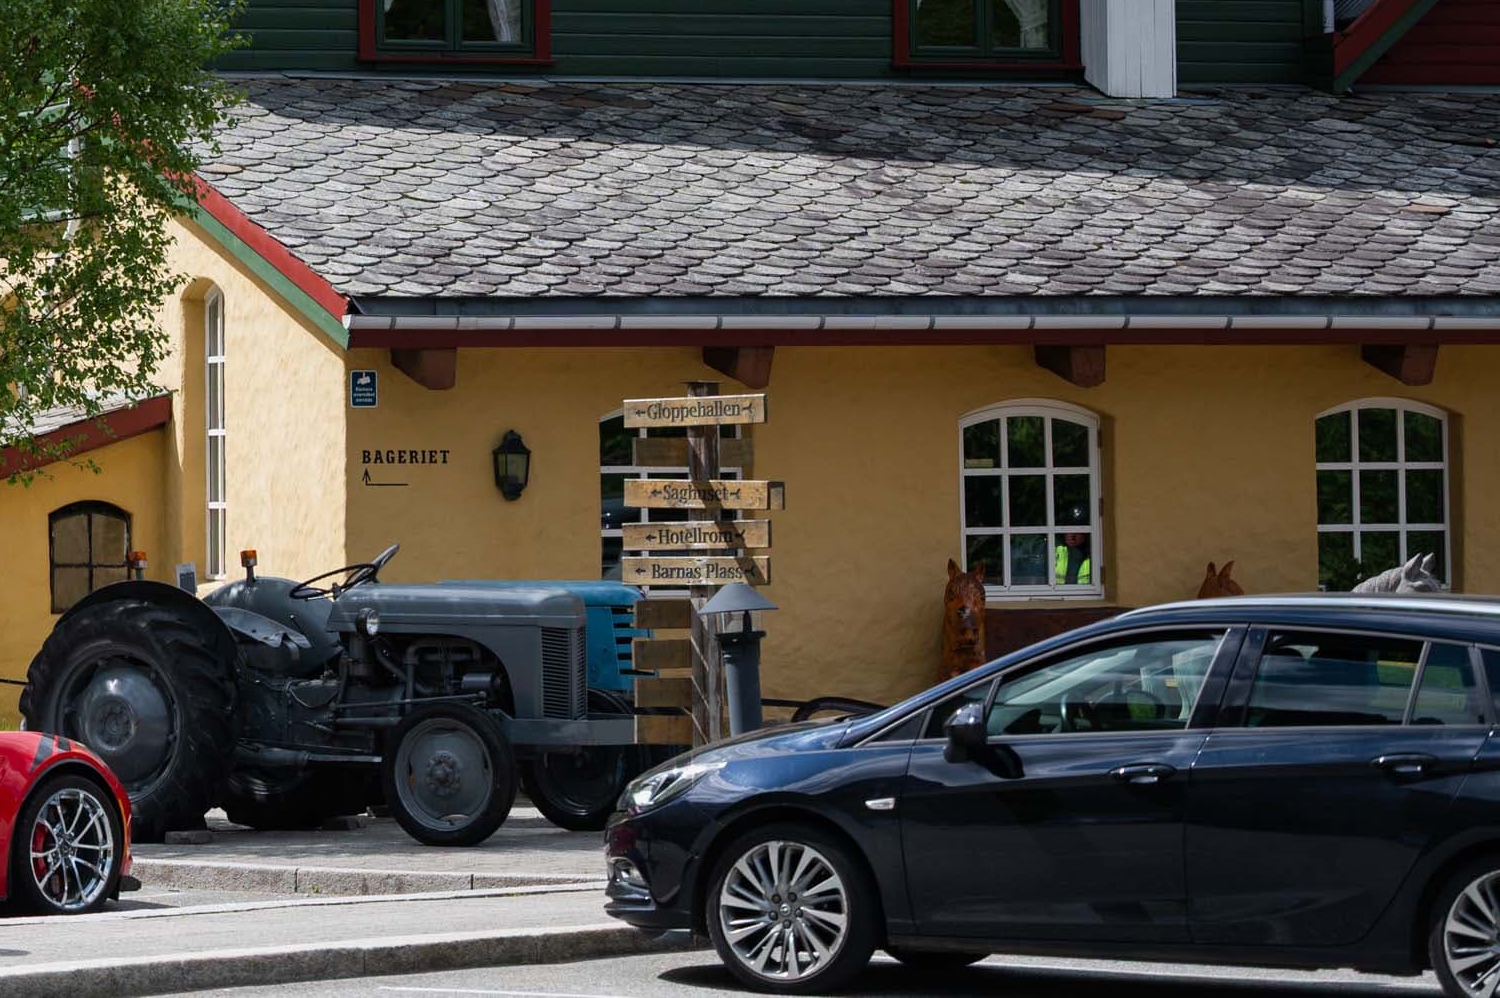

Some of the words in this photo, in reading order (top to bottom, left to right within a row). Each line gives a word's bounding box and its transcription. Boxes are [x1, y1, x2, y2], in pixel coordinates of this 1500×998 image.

[646, 400, 741, 421] Gloppehallen
[362, 450, 450, 464] BAGERIET
[663, 484, 730, 503] Saghuset
[658, 527, 733, 545] Hotellrom
[652, 564, 701, 579] Barnas
[706, 563, 743, 579] Plass
